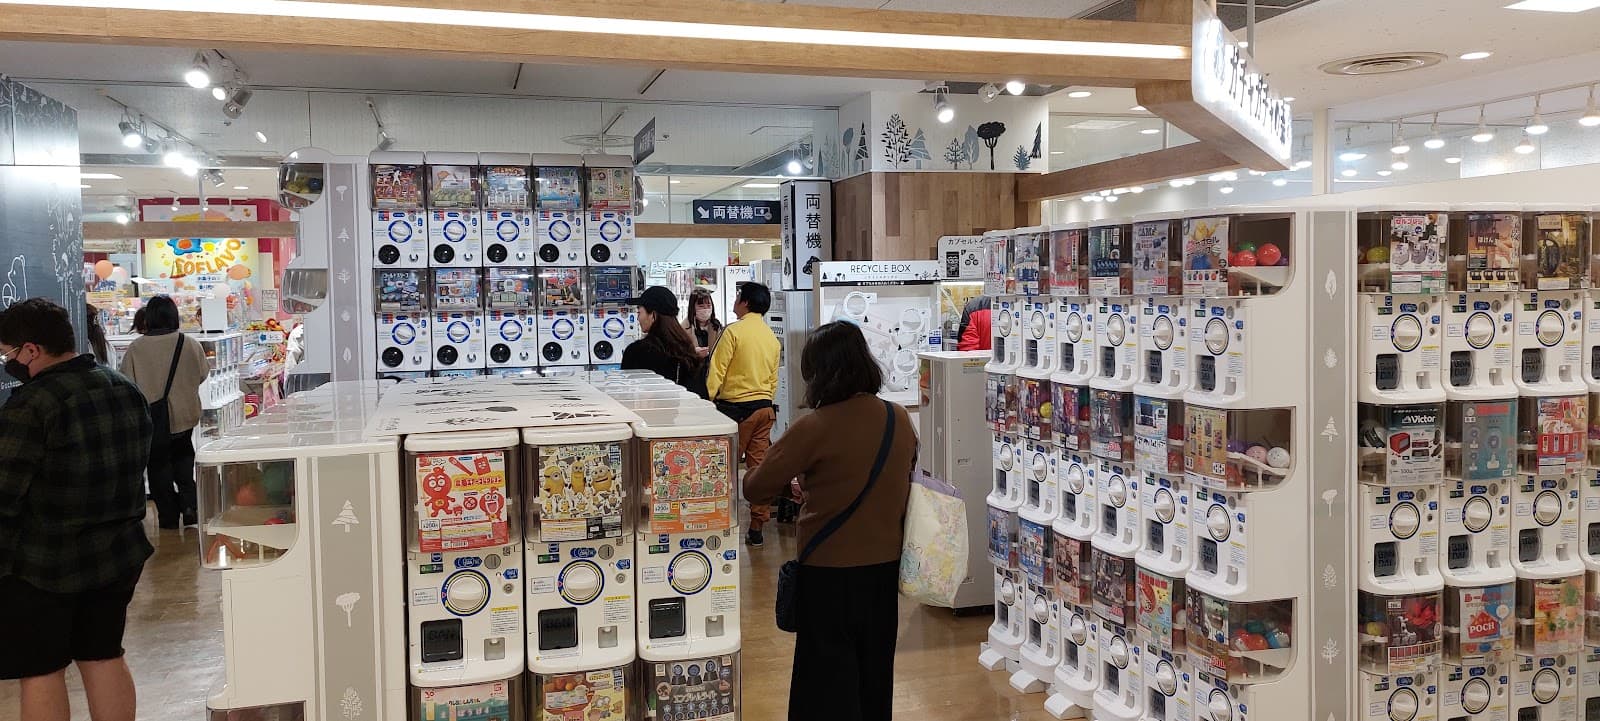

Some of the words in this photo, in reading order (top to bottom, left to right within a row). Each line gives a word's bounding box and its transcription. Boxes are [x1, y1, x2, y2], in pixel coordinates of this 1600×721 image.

[713, 205, 754, 220] 両替機
[805, 193, 821, 249] 両替機
[850, 264, 889, 273] RECYCLE
[891, 264, 911, 273] BOX
[1411, 415, 1436, 423] Victor
[1469, 622, 1495, 634] POCH
